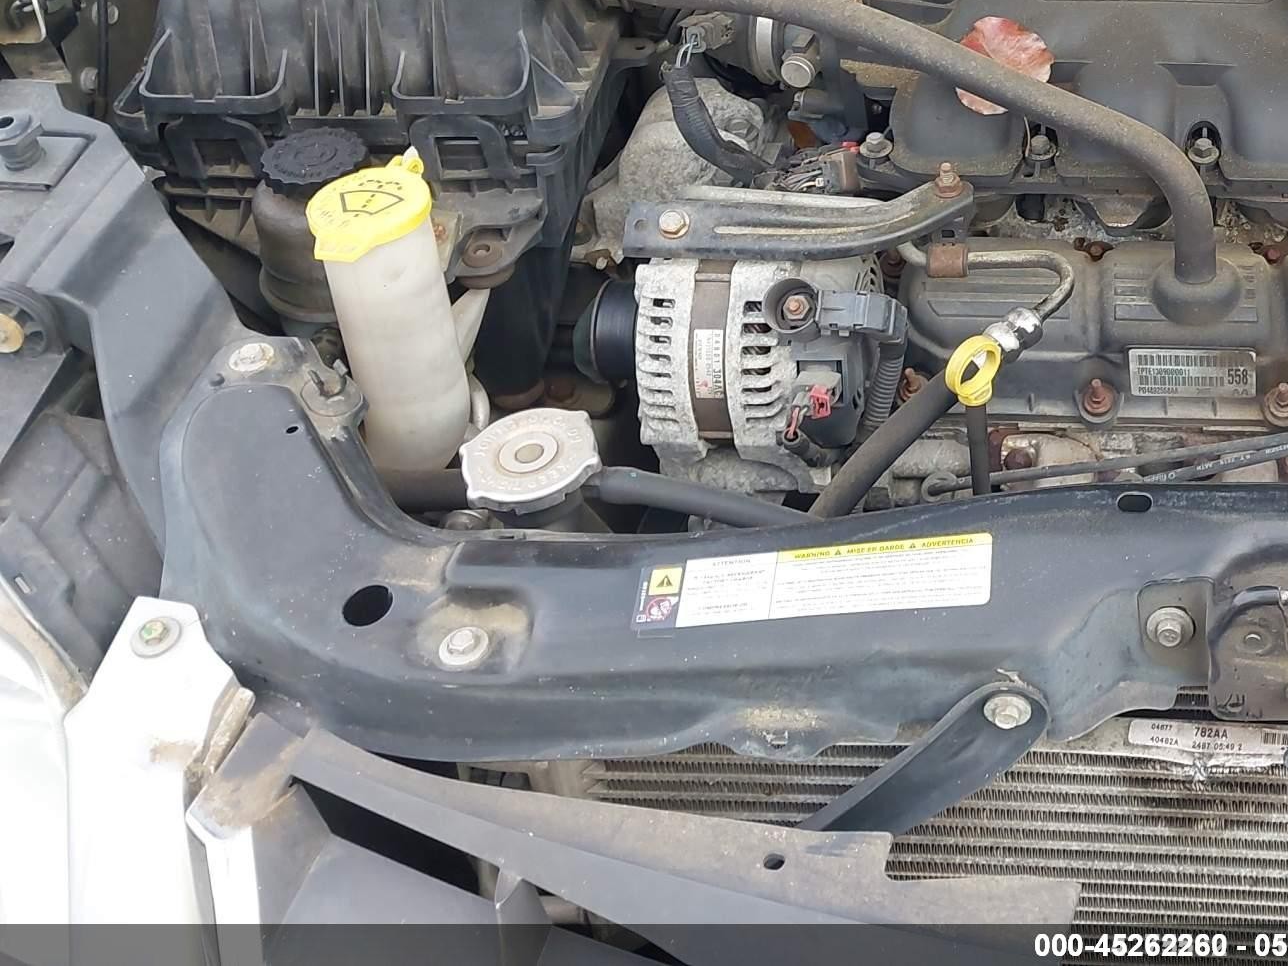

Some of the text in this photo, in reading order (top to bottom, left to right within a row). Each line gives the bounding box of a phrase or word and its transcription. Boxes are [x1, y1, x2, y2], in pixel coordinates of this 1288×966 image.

[1227, 368, 1249, 386] 558
[794, 550, 831, 559] WARNING
[879, 544, 905, 552] GARDE
[921, 538, 974, 548] ADVERTENCIA
[1193, 726, 1229, 739] 782AA
